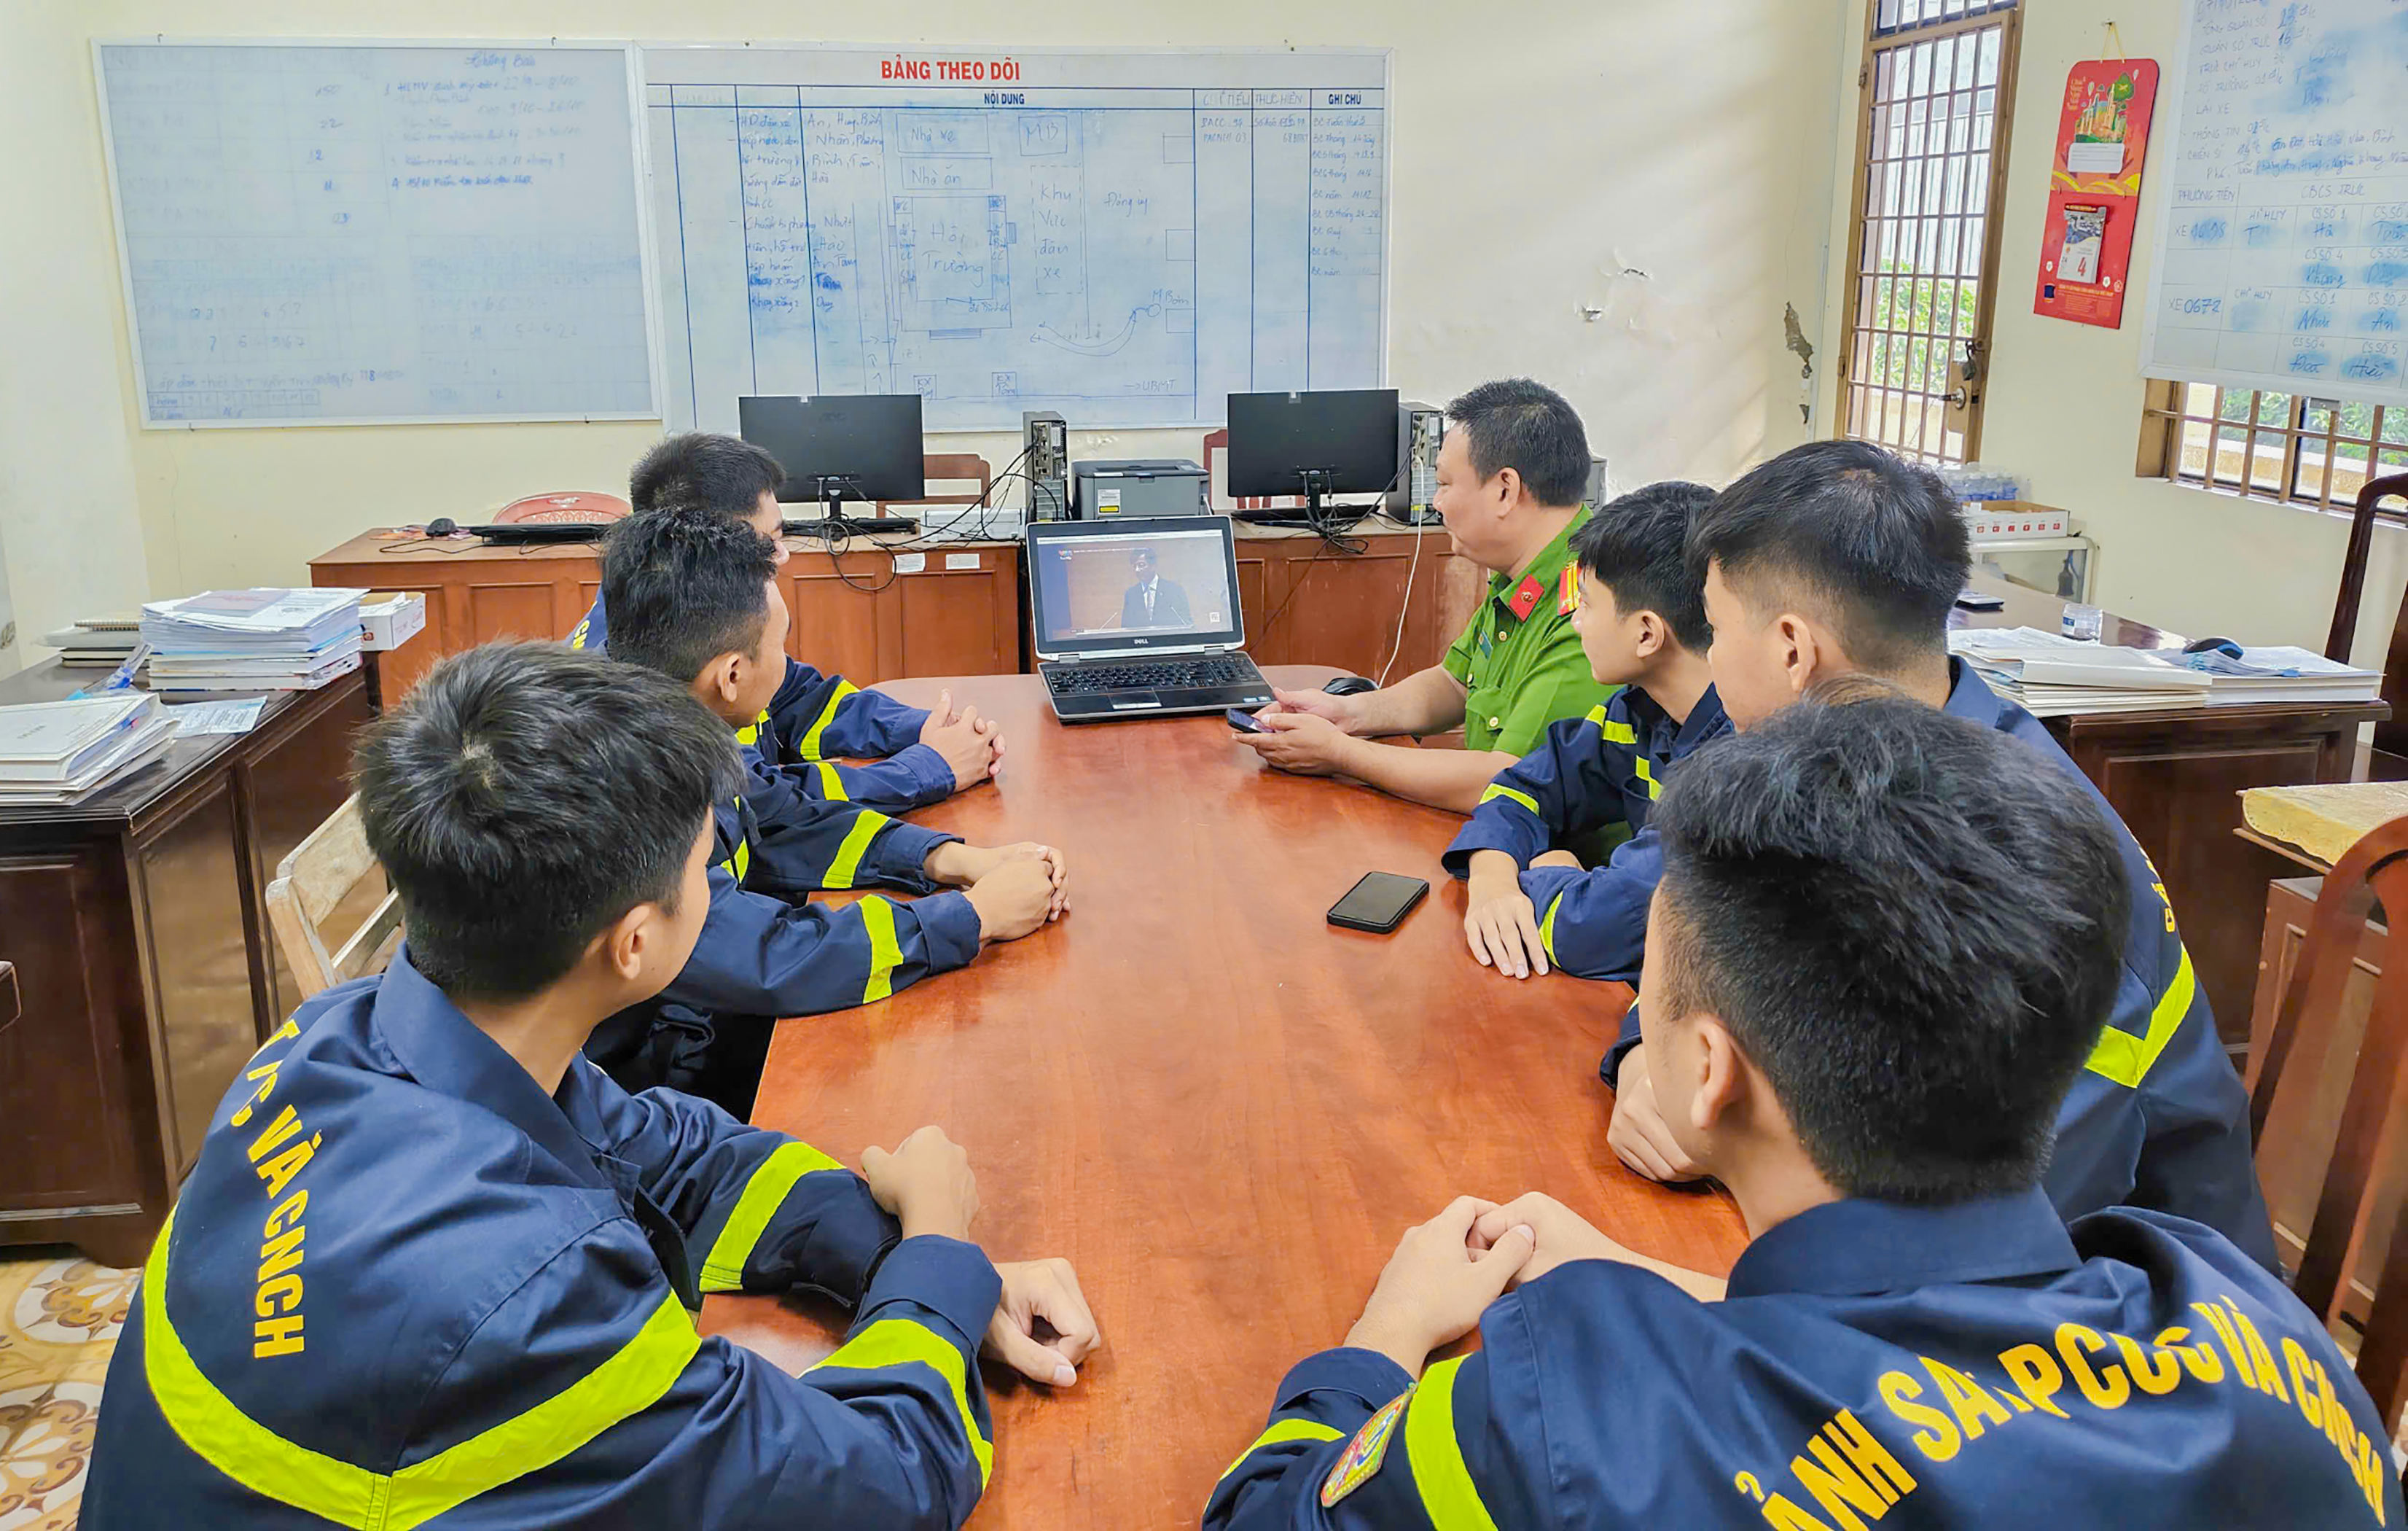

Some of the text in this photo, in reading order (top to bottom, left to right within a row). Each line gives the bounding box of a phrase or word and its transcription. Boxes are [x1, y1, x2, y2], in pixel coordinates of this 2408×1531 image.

[881, 54, 1020, 80] BẢNG THEO DÕI
[1001, 93, 1025, 105] DUNG
[1329, 90, 1361, 105] GHI CHÚ
[2077, 257, 2087, 277] 4
[2184, 297, 2223, 315] 0672
[247, 1104, 322, 1200] VÀ
[254, 1189, 309, 1360] CNCH
[1735, 1407, 1918, 1531] ẢNH
[1877, 1355, 2034, 1457] SÁ
[2189, 1294, 2291, 1403] VÀ
